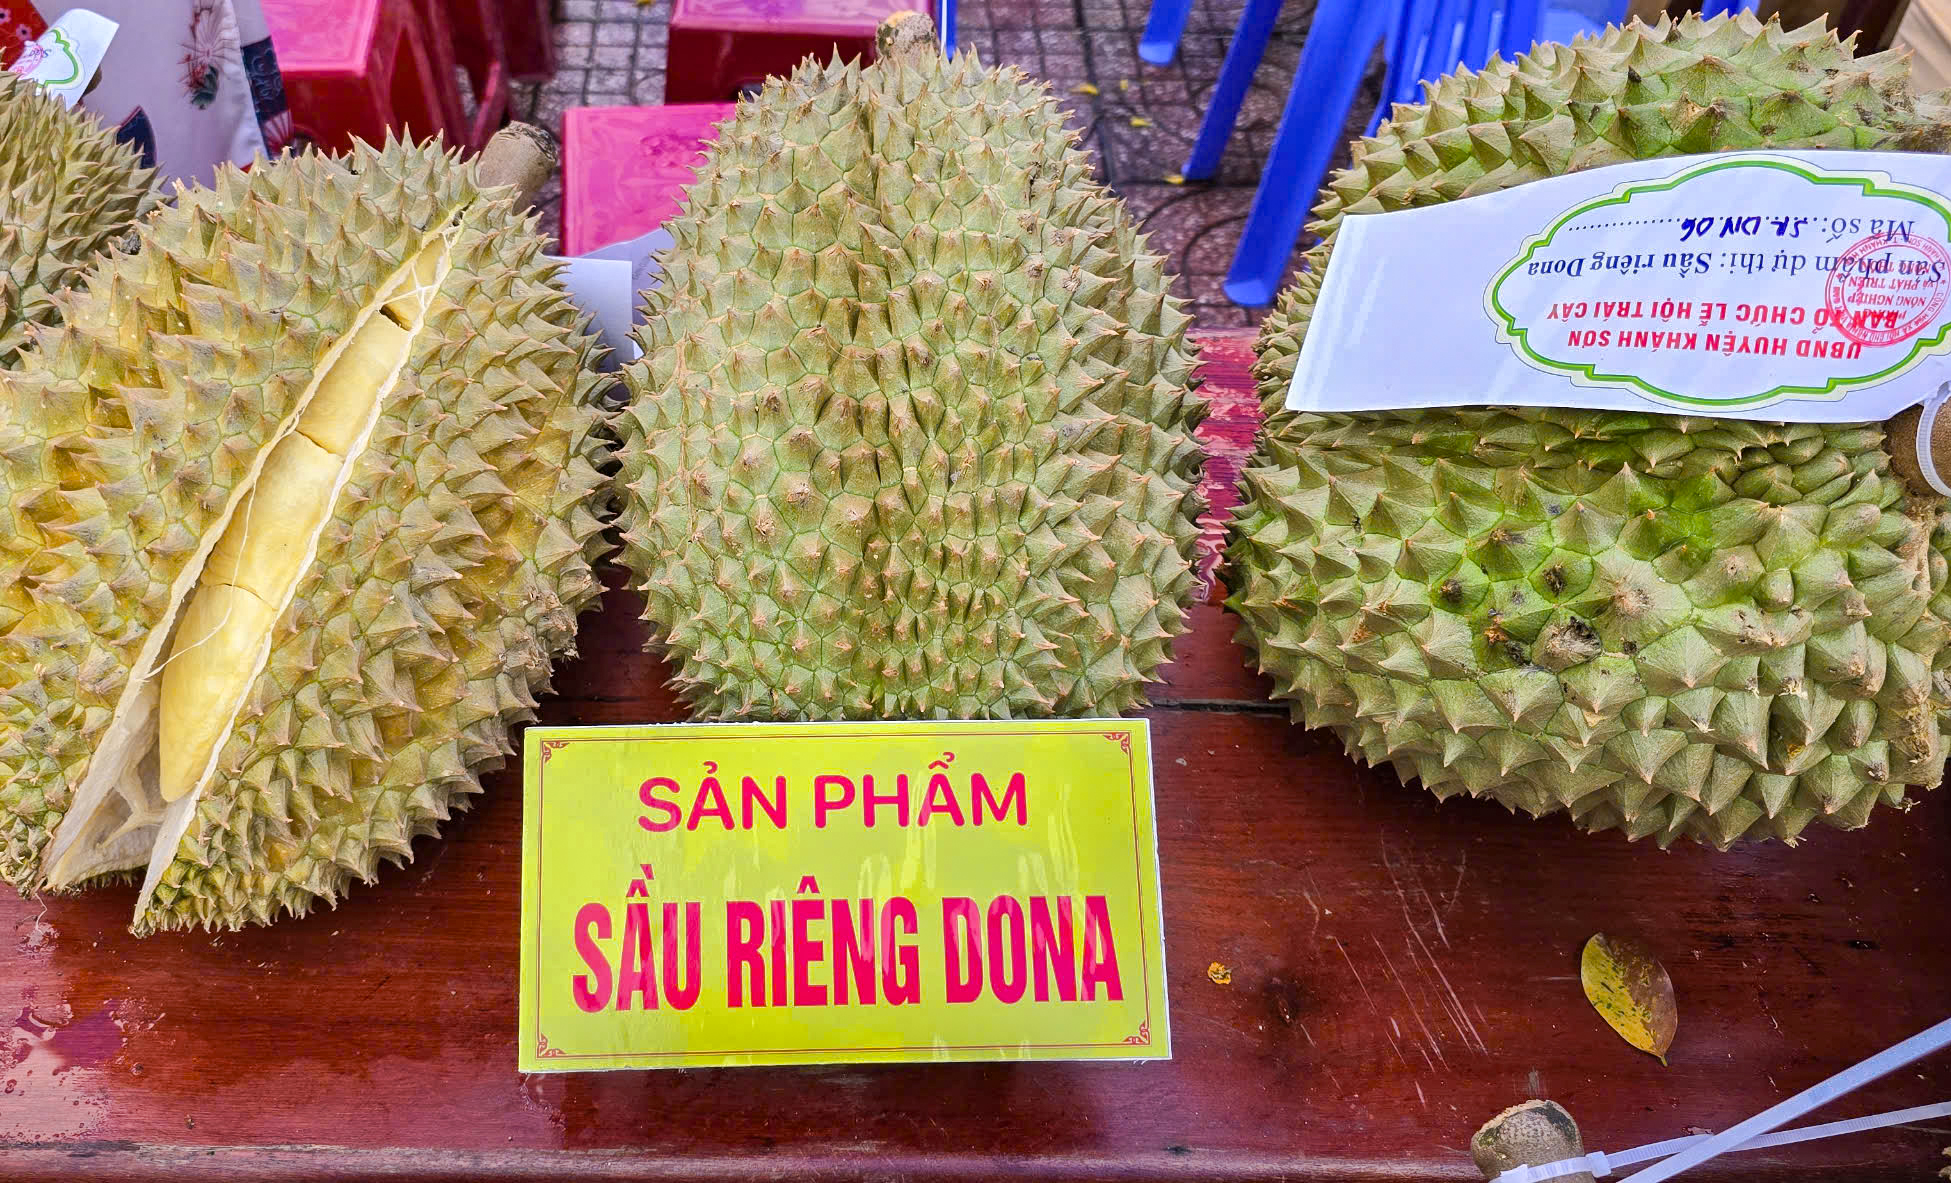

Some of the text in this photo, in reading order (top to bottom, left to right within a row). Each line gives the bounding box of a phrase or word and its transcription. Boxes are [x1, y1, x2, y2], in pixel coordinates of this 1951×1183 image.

[1870, 219, 1914, 243] Mã
[1527, 257, 1585, 278] Dona
[1589, 251, 1655, 276] riêng
[1662, 253, 1712, 278] Sầu
[1719, 253, 1764, 275] thi:
[1771, 249, 1806, 276] dự
[1815, 252, 1893, 284] phẩm
[1898, 260, 1945, 283] Sản
[1546, 302, 1588, 323] CÂY
[1593, 302, 1643, 321] TRÁI
[1650, 298, 1692, 323] HỘI
[1698, 303, 1727, 327] LỄ
[1735, 304, 1806, 326] CHỨC
[1852, 310, 1898, 329] BAN
[1567, 330, 1861, 359] UBND HUYỆN KHÁNH SƠN
[638, 752, 1028, 832] SẢN PHẨM
[572, 864, 1124, 1013] SẦU RIÊNG DONA
